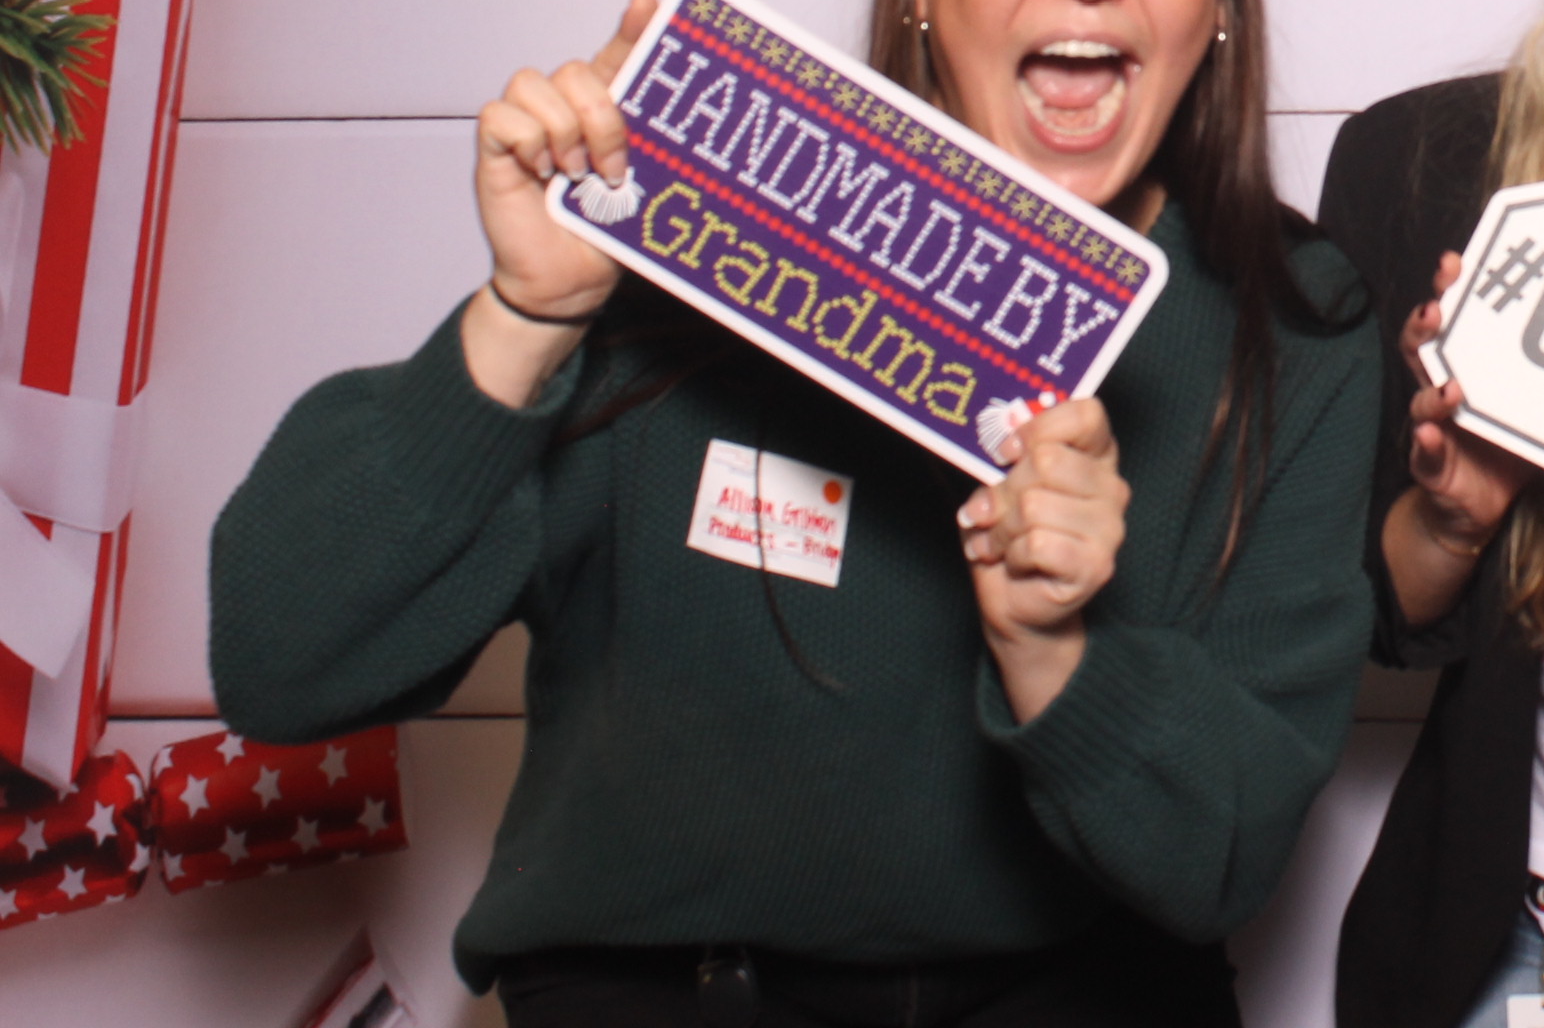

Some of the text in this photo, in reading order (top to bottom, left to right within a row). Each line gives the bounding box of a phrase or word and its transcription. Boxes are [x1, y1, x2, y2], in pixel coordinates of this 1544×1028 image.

[622, 34, 1119, 375] HANDMADE BY
[640, 180, 978, 427] Grandma
